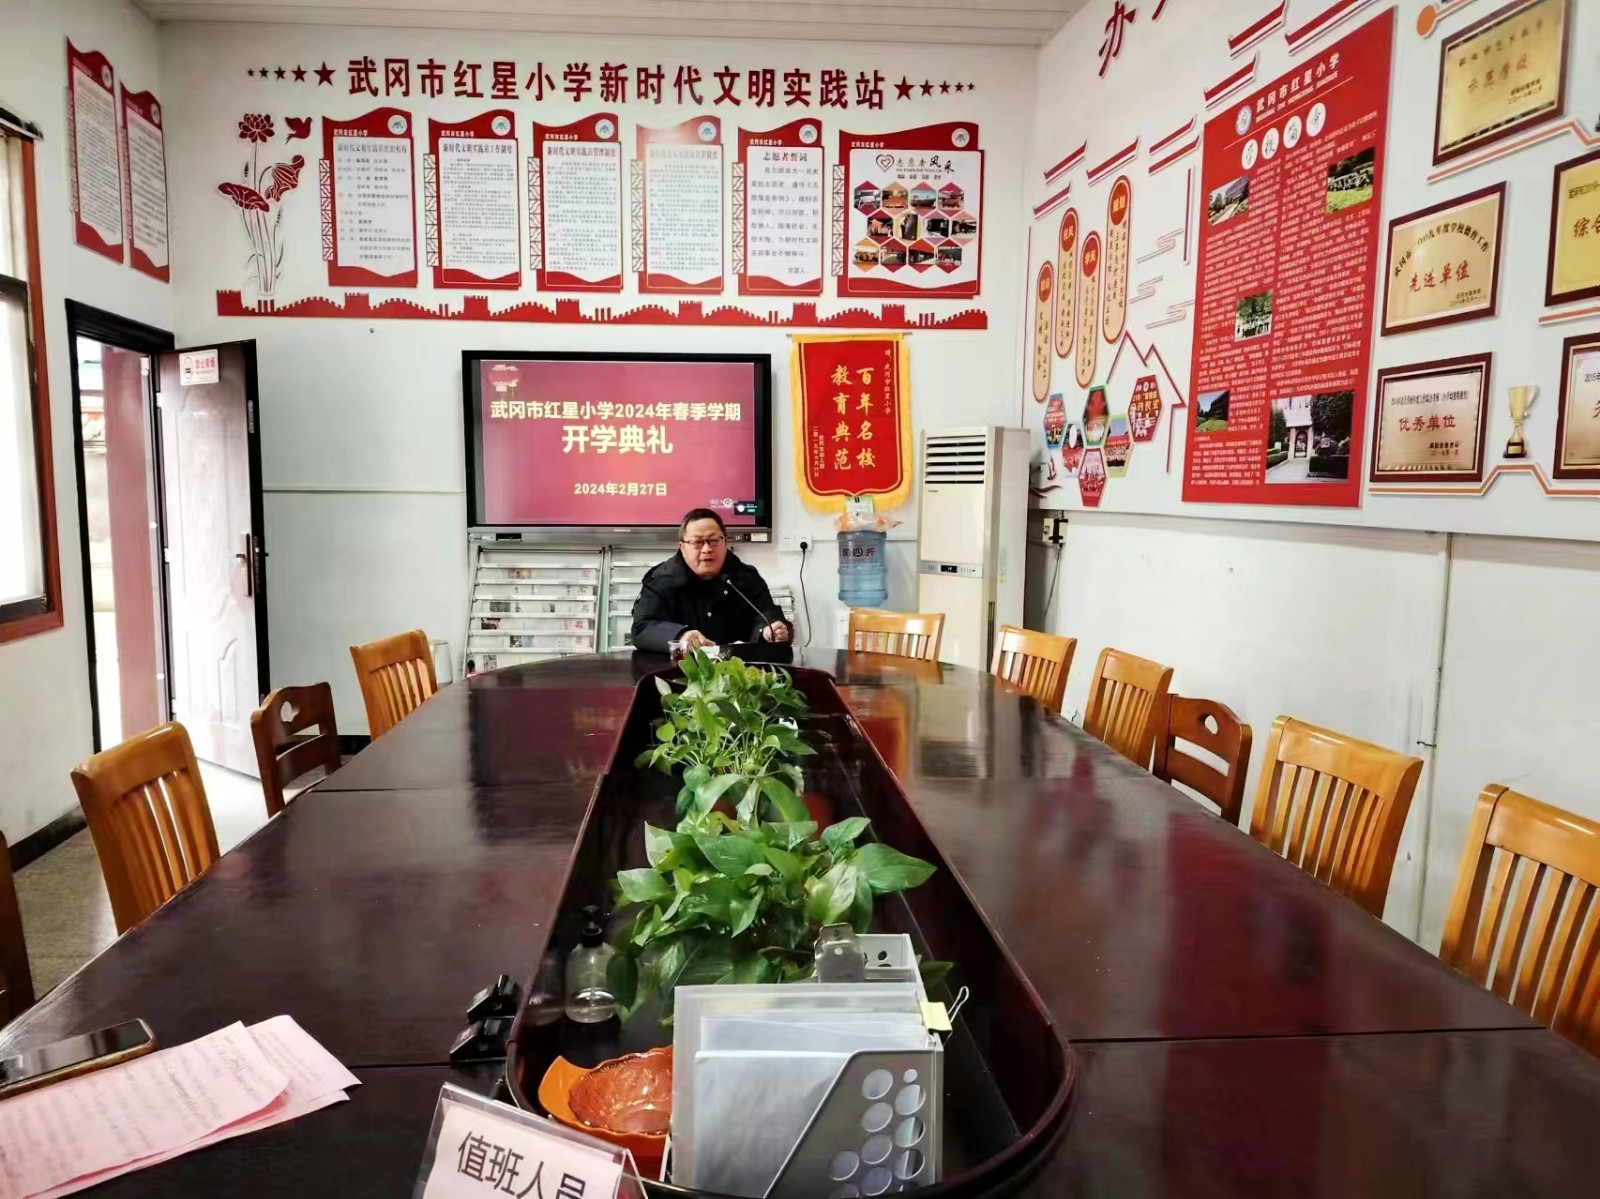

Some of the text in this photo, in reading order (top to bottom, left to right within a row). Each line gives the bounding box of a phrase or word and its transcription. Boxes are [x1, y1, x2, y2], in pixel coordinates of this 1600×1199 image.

[348, 56, 885, 110] 武冈市红星小学新时代文明实践站
[1256, 52, 1339, 113] 武冈市红星小学
[1395, 222, 1489, 277] 武冈市〇〇九年度学校德育工作
[1410, 259, 1470, 293] 先进单位
[490, 400, 741, 421] 武冈市红星小学2024年春季学期
[831, 364, 853, 470] 教育典范
[856, 367, 876, 468] 百年名校
[1399, 414, 1456, 432] 优秀单位
[562, 425, 673, 454] 开学典礼
[574, 481, 667, 496] 2024年2月27日
[458, 1131, 586, 1199] 值班人员
